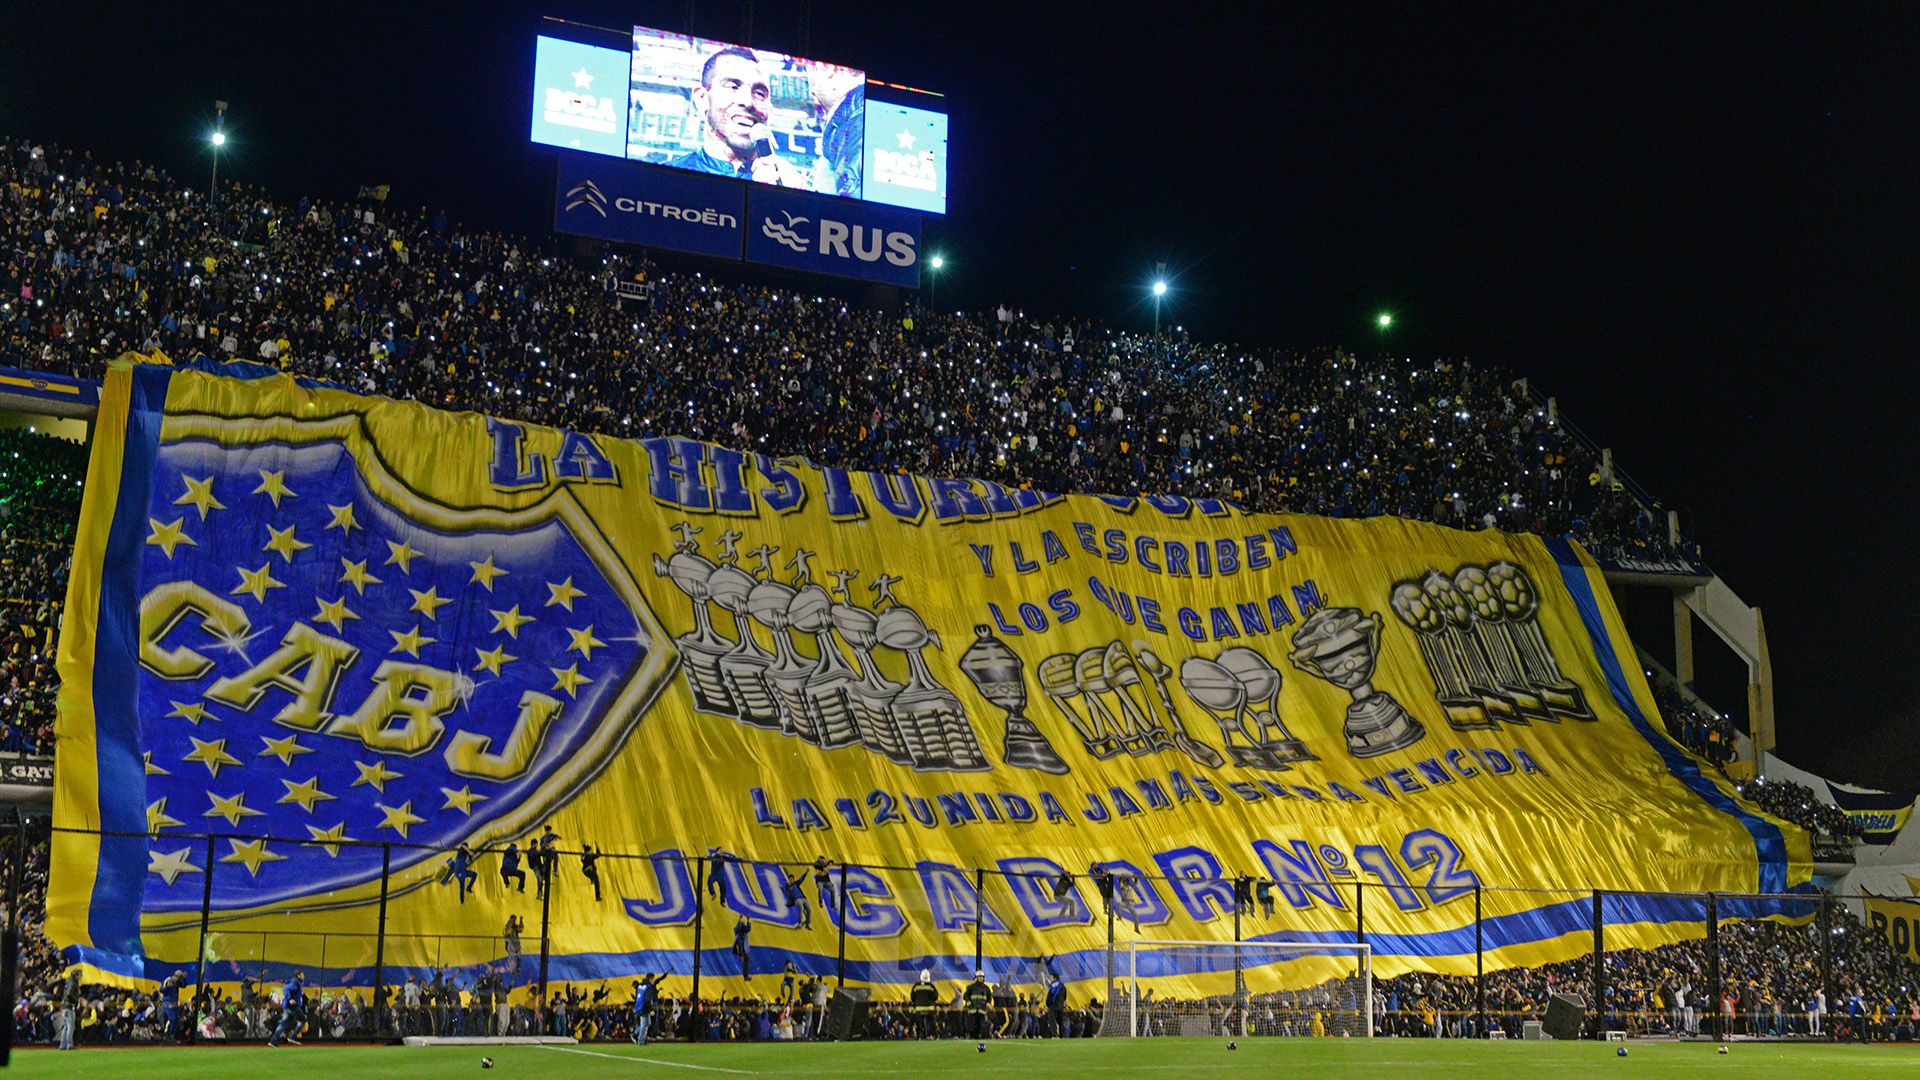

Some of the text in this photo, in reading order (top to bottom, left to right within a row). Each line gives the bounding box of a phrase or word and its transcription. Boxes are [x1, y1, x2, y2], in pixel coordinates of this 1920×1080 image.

[819, 219, 917, 267] RUS
[485, 414, 623, 493] LA
[968, 521, 1298, 578] Y LA ESCRIBEN
[987, 575, 1323, 642] LOS QUE GANAN
[139, 580, 565, 784] CABJ
[749, 786, 831, 834] LA
[900, 790, 1075, 830] UNIDA
[1082, 769, 1224, 824] JAMAS
[1360, 746, 1551, 806] VENCIDA
[621, 845, 1236, 939] JUGADOR
